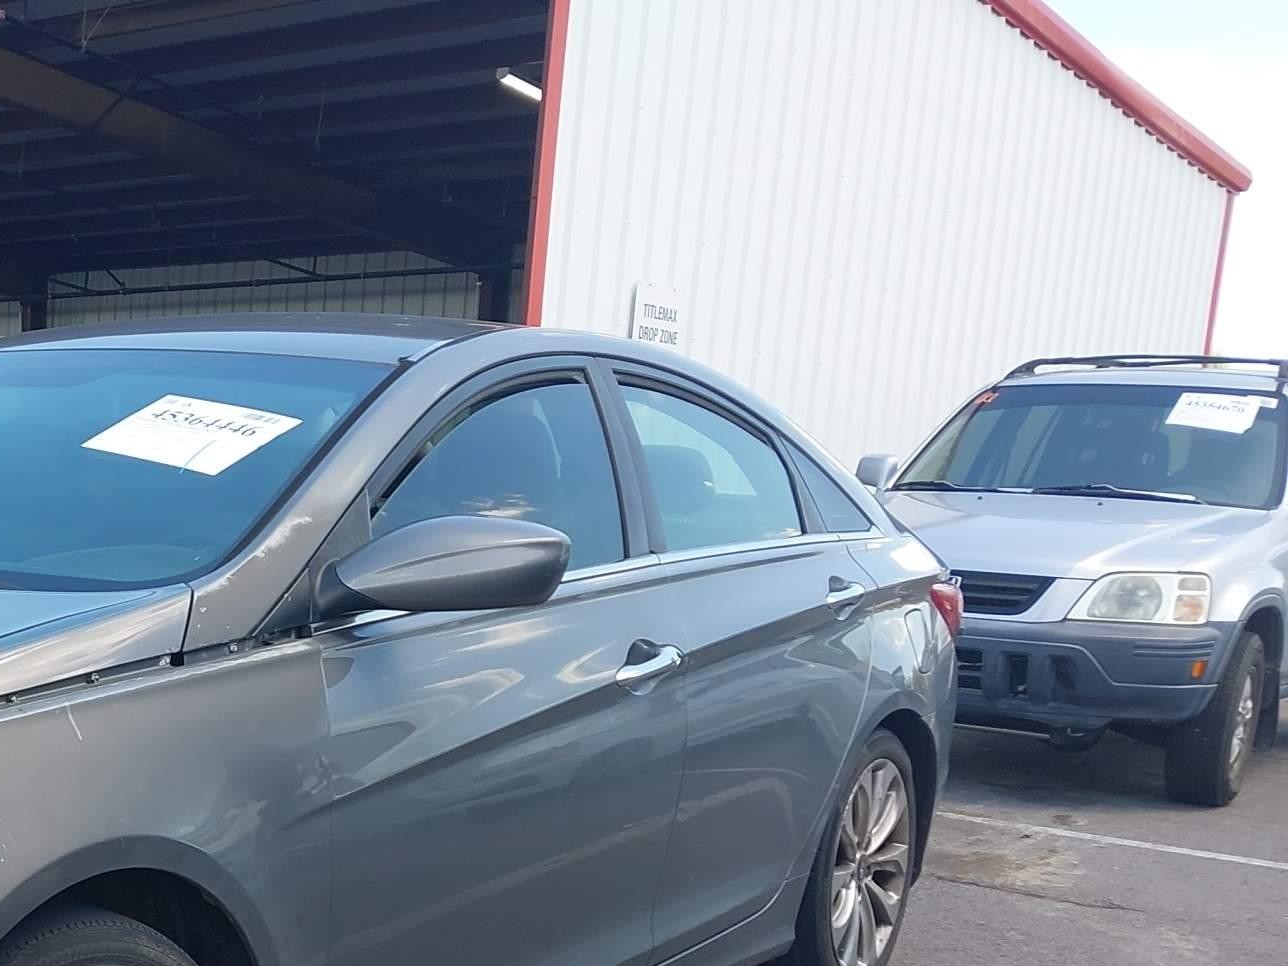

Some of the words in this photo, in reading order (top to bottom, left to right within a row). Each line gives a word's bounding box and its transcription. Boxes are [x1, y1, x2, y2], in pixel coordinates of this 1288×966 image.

[643, 303, 679, 323] TITLEMAX
[638, 325, 659, 343] DROP
[659, 329, 679, 345] ZONE
[152, 409, 264, 437] 45364446
